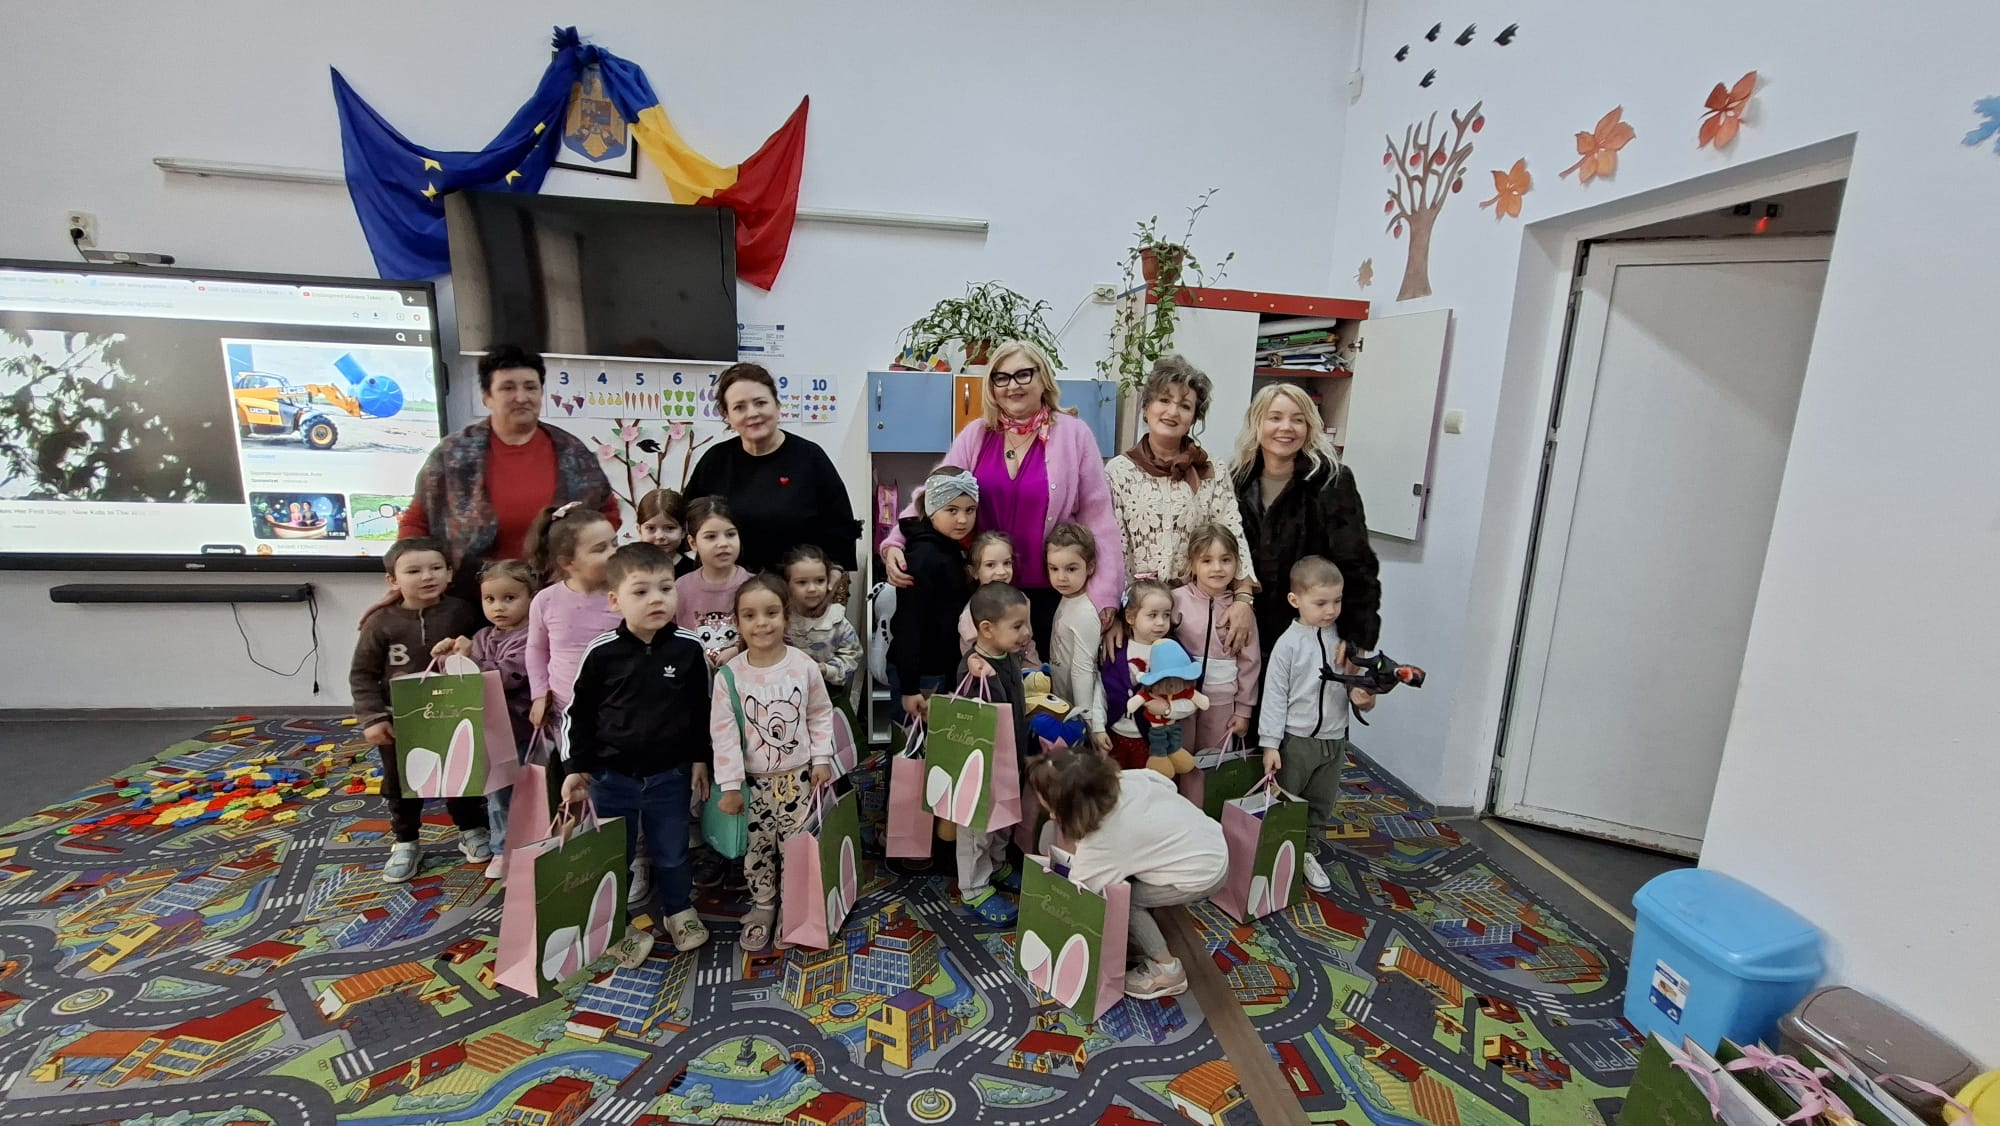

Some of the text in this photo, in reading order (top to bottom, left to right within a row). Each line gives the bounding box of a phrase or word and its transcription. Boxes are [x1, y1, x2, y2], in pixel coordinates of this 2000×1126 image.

[560, 371, 569, 385] 3
[597, 372, 608, 385] 4
[635, 372, 645, 386] 5
[672, 372, 683, 385] 6
[708, 374, 718, 386] 7
[778, 376, 788, 389] 9
[812, 378, 827, 391] 10
[388, 643, 410, 666] B
